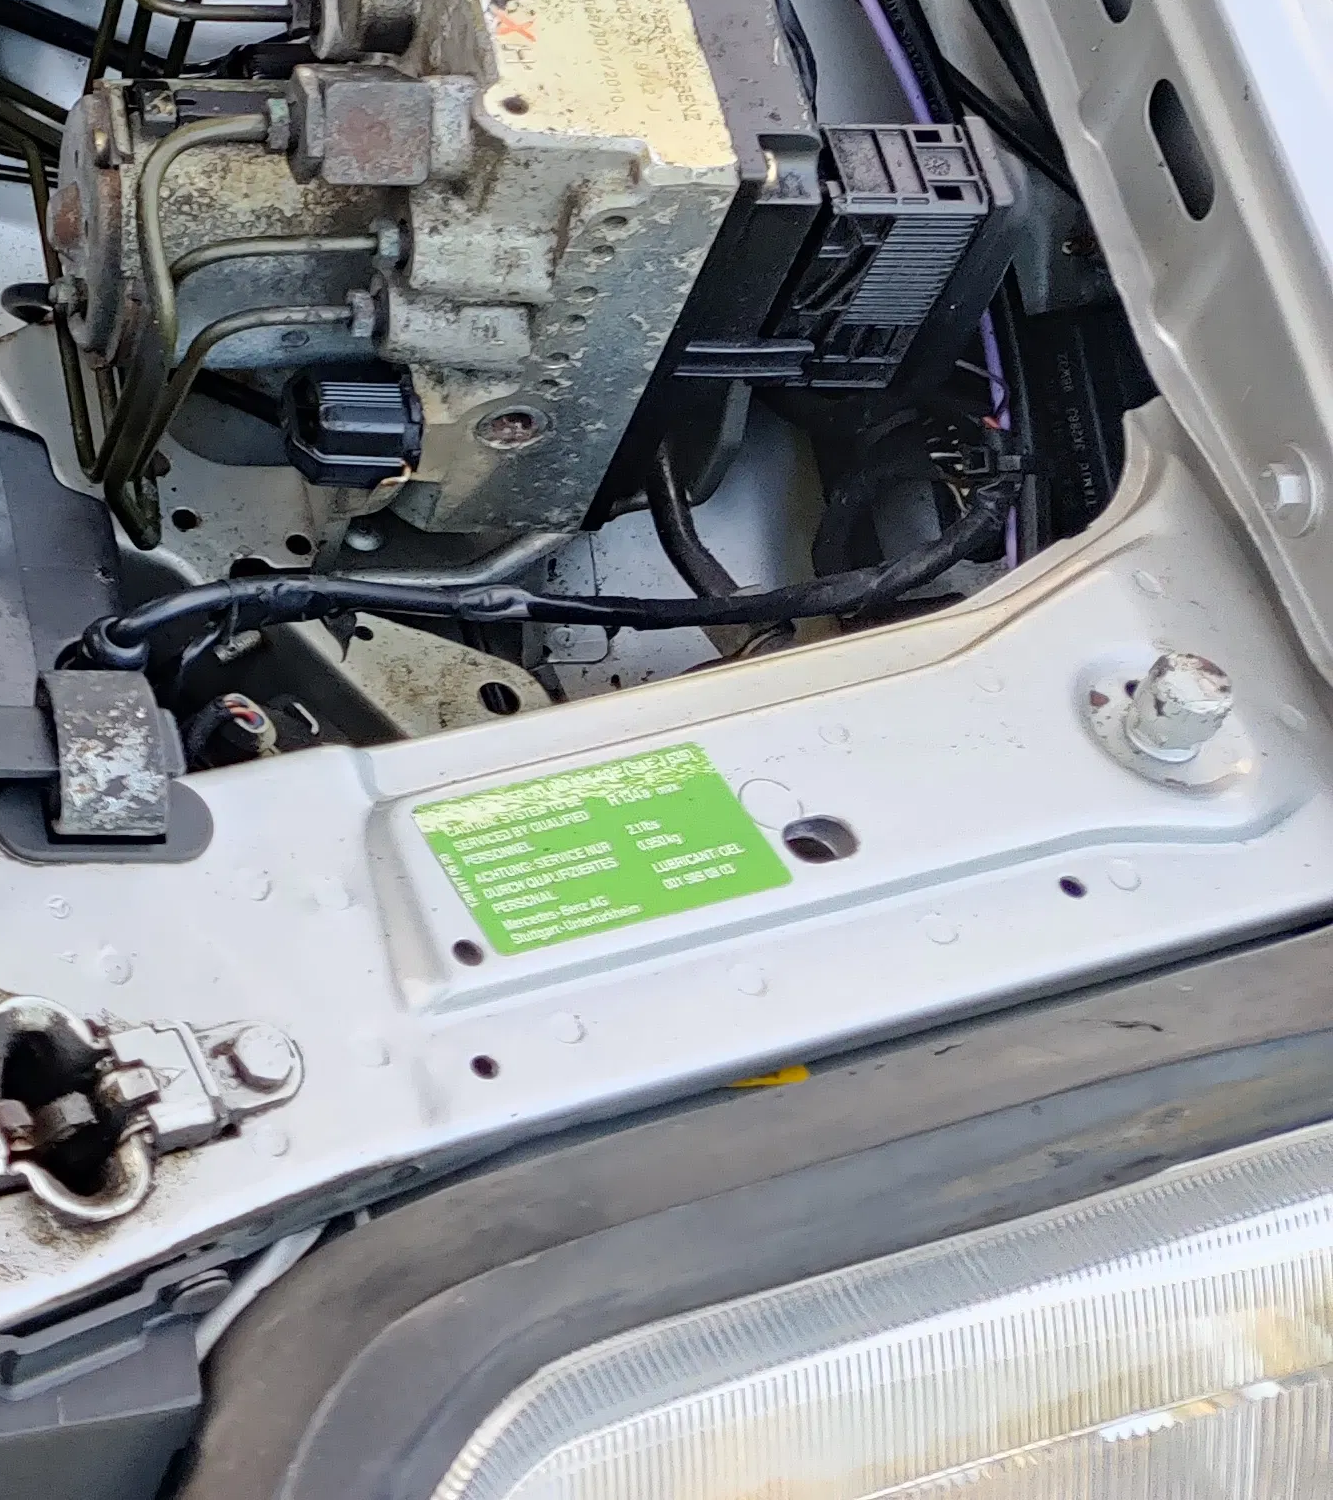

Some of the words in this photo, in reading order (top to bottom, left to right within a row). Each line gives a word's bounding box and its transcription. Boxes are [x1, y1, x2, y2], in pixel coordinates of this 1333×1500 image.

[452, 829, 514, 852] SERVICED
[511, 825, 531, 838] BY
[529, 810, 590, 833] QUALIFIED
[461, 841, 535, 866] PERSONNEL
[533, 846, 583, 869] SERVICE
[582, 841, 612, 854] NUR
[482, 881, 526, 900] DURCH
[491, 891, 561, 914] PERSONAL
[590, 895, 610, 908] AG
